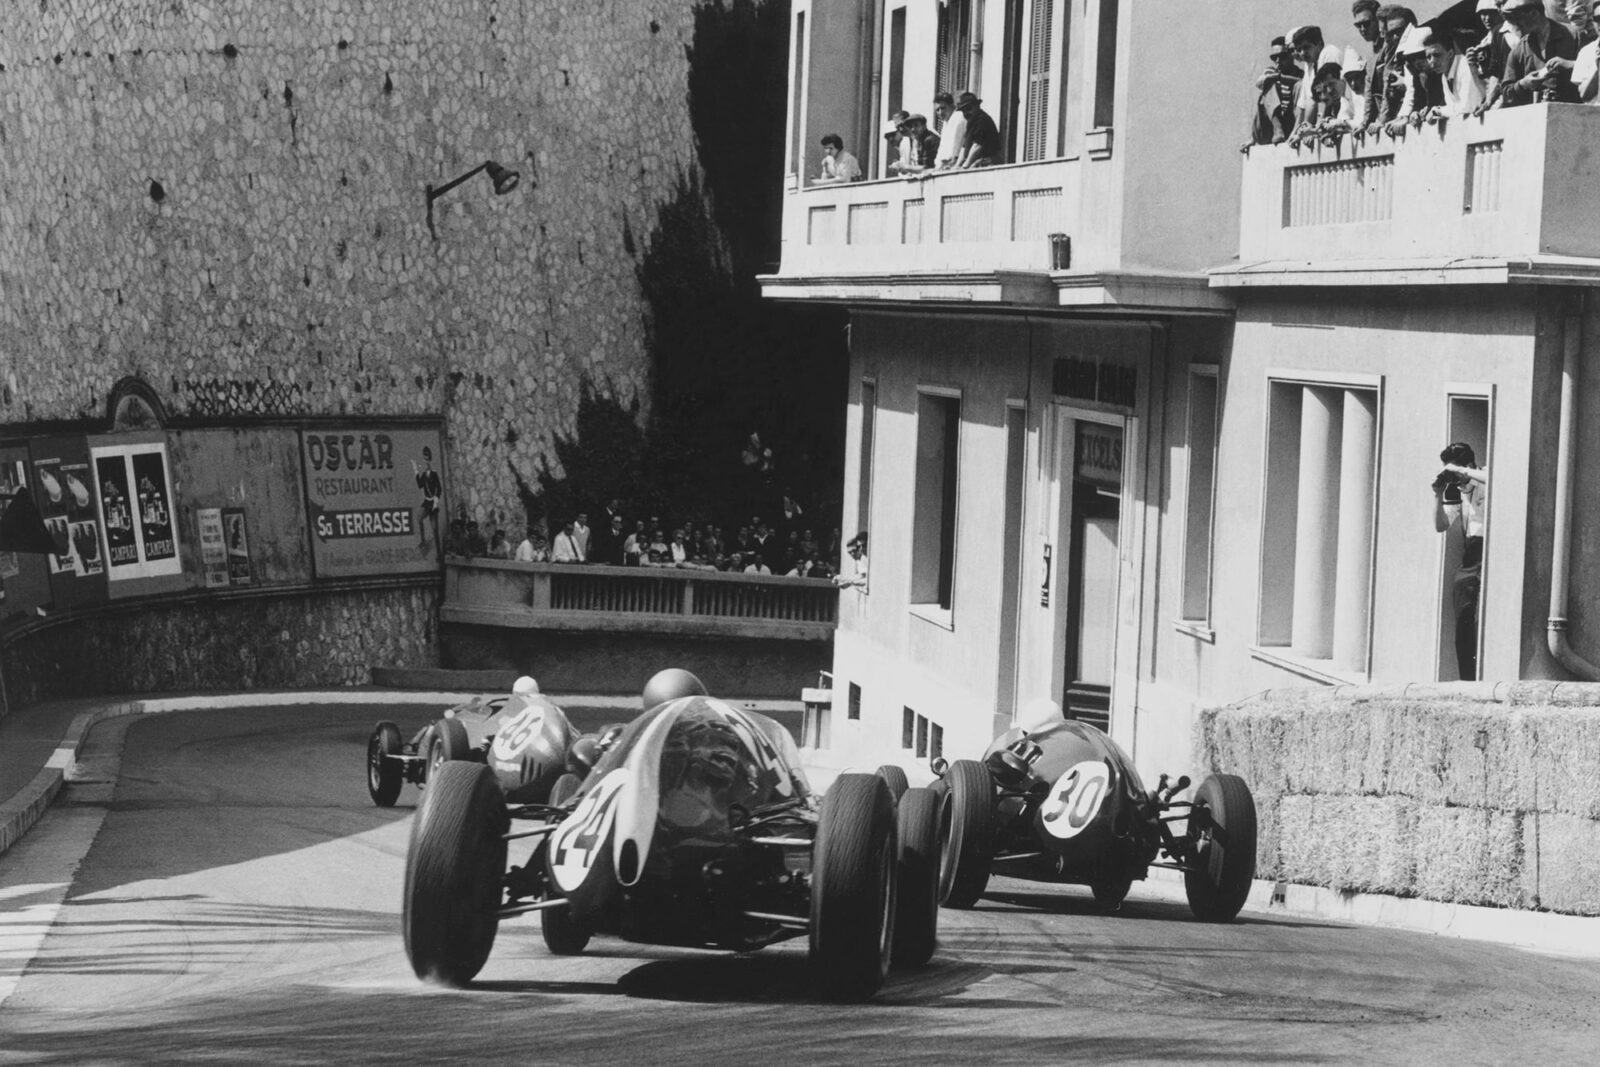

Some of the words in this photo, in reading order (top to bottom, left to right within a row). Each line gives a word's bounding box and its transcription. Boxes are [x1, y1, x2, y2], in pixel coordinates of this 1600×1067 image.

[306, 434, 393, 471] OSCAR
[314, 477, 393, 499] RESTAURANT
[317, 515, 333, 536] Sa
[336, 511, 410, 535] TERRASSE
[111, 544, 137, 562] CAMPARI
[146, 538, 173, 557] CAMPARI
[499, 713, 541, 750] 46
[1044, 770, 1105, 829] 30
[555, 786, 621, 868] 24
